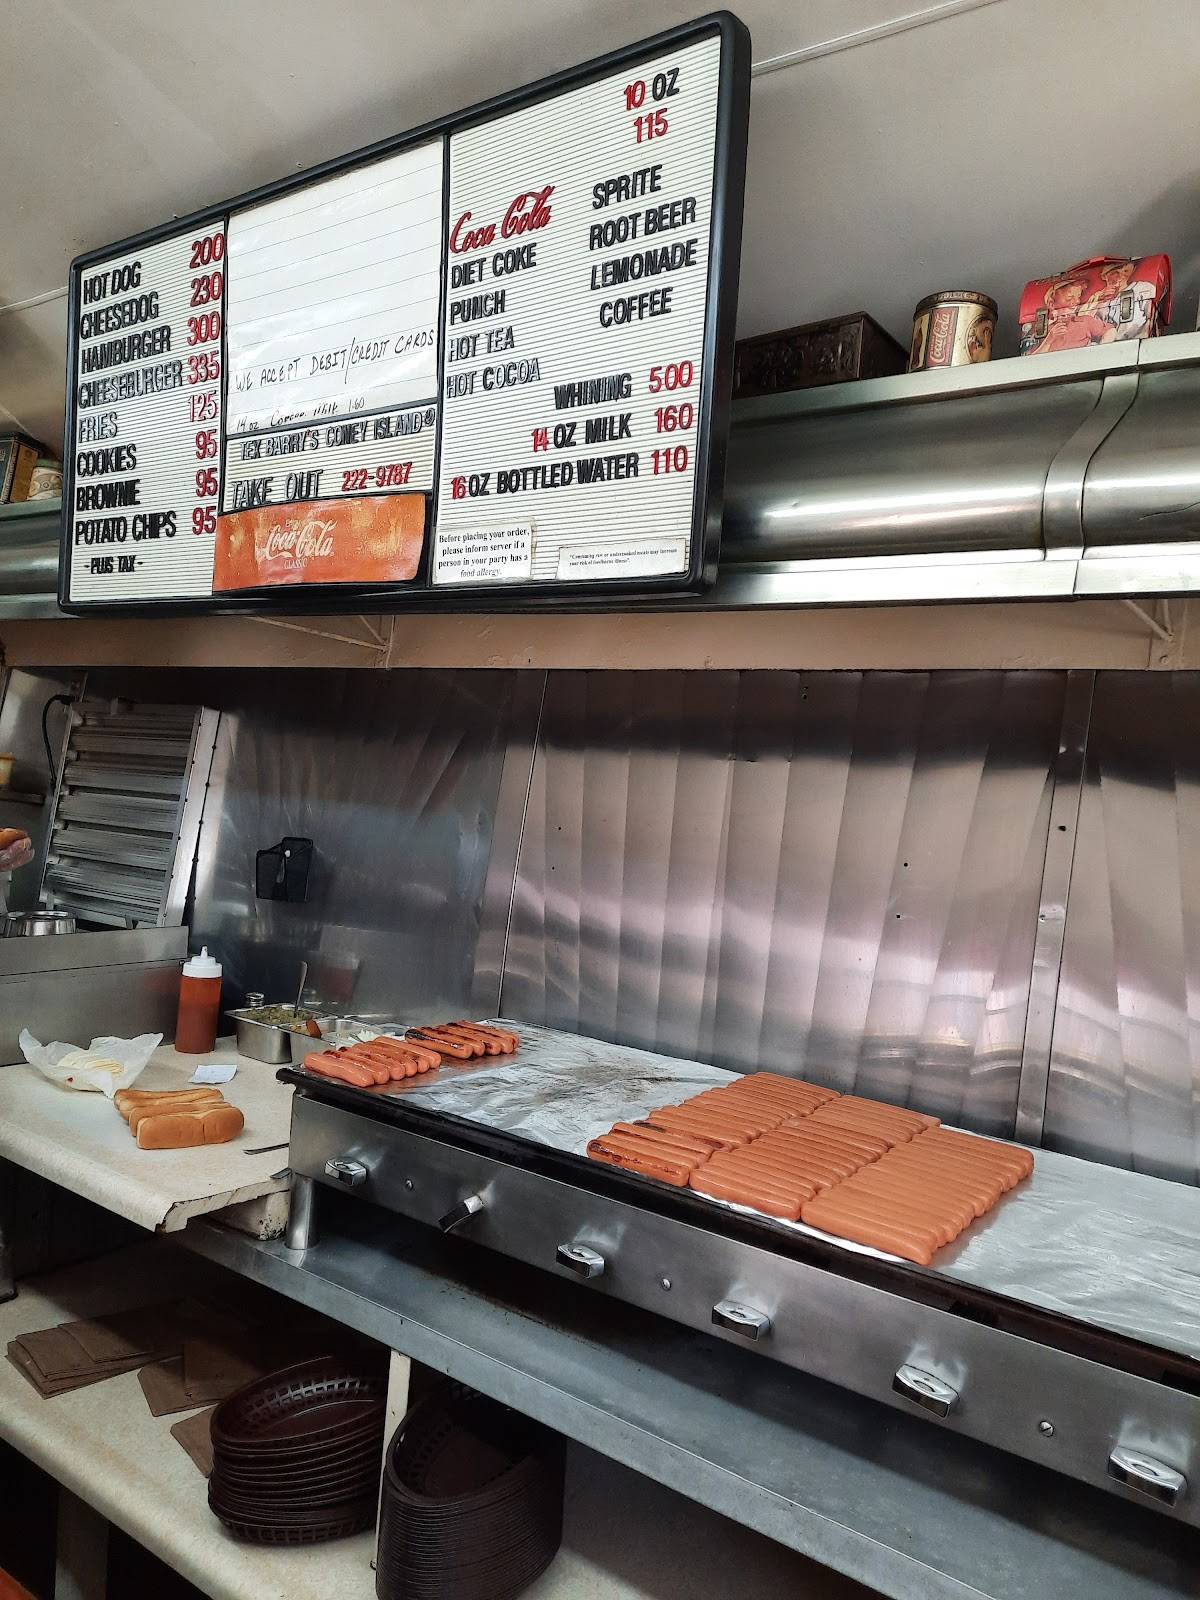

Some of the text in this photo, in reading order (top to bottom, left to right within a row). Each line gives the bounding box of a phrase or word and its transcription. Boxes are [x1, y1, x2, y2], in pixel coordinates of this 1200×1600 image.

[624, 67, 680, 110] 10 OZ
[633, 107, 668, 143] 115
[592, 164, 663, 209] SPRITE
[450, 185, 555, 254] Coca Cola
[589, 196, 697, 251] ROOT BEER
[83, 233, 225, 305] HOT DOG 200
[451, 242, 537, 289] DIET COKE
[590, 238, 699, 290] LEMONADE
[80, 271, 223, 339] CHEESEDOG 230
[450, 289, 506, 325] PUNCH
[600, 286, 673, 328] COFFEE
[81, 311, 221, 374] HAMBURGER 300
[236, 372, 253, 392] WE
[260, 358, 301, 387] ACCEPT
[394, 329, 434, 354] CARDS
[449, 326, 515, 362] HOT TEA
[78, 360, 183, 409] CHEESEBURGER
[446, 358, 541, 398] HOT COCOA
[553, 360, 694, 410] WHINING 500
[78, 390, 218, 443] FRIES 125
[240, 441, 261, 460] TEX
[265, 429, 319, 456] BARRY'S
[325, 420, 369, 447] CONEY
[531, 402, 694, 453] 14 OZ MILK 160
[77, 429, 217, 478] COOKIES 95
[451, 445, 689, 500] 16 OZ BOTTLED WATER 110
[195, 467, 218, 498] 95
[231, 462, 413, 509] TAKE OUT 222-9787
[75, 506, 217, 546] POTATO CHIPS 95
[439, 528, 530, 543] Before placing your order,
[442, 546, 464, 556] please
[465, 545, 489, 554] inform
[490, 542, 512, 551] server
[514, 541, 521, 549] if
[438, 560, 461, 570] person
[463, 558, 470, 566] in
[471, 558, 487, 567] your
[489, 556, 508, 566] party
[460, 569, 475, 578] food
